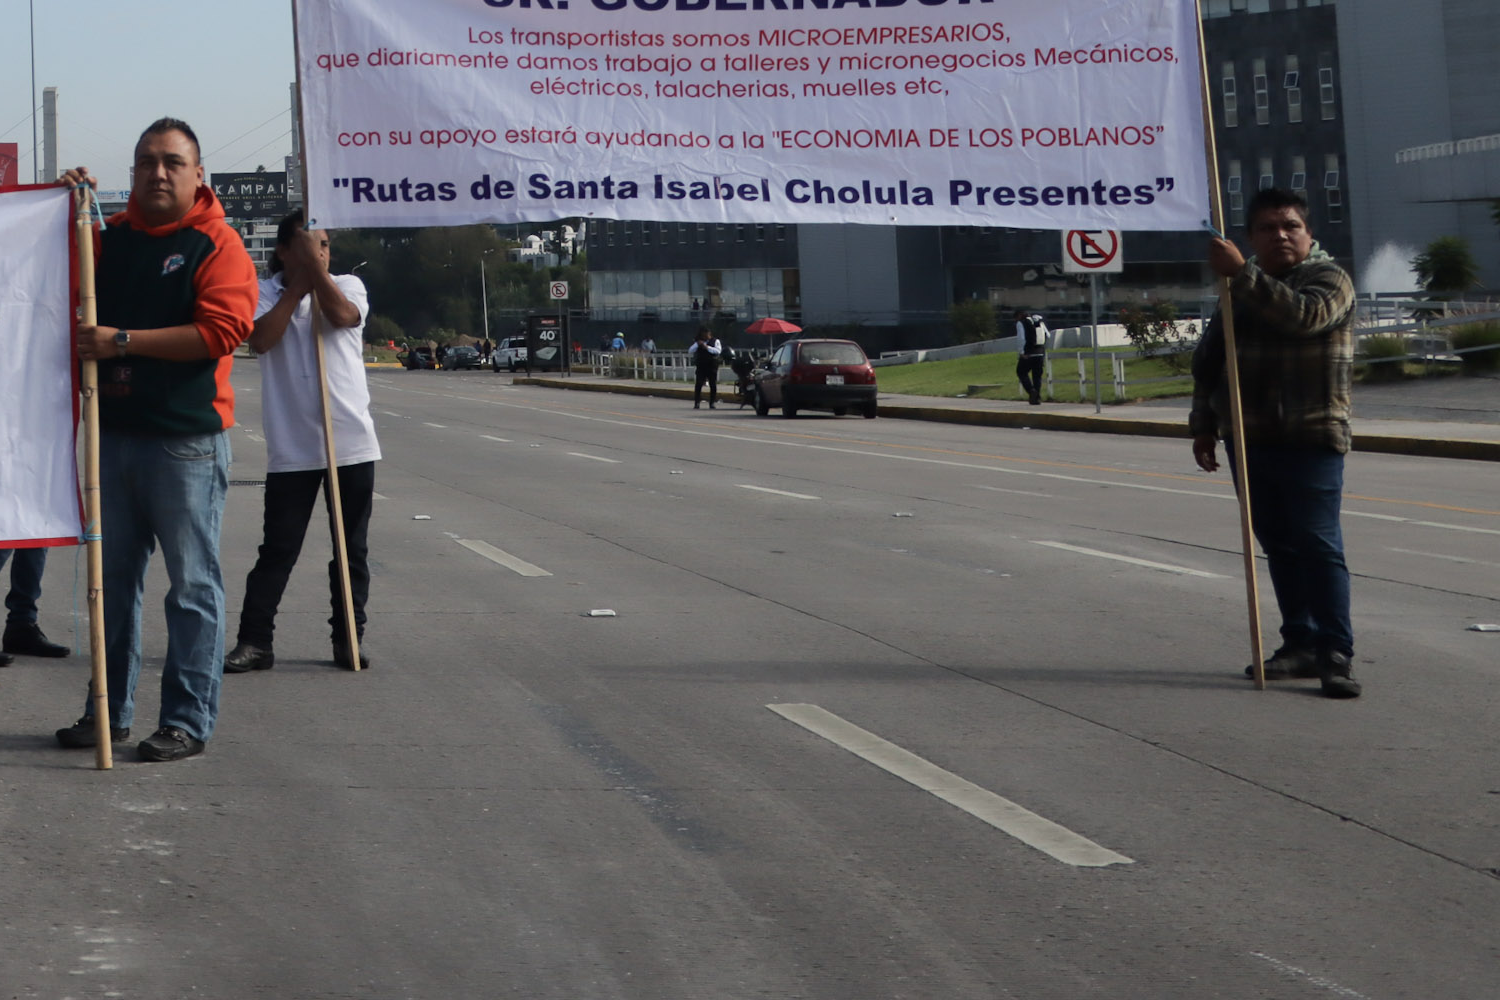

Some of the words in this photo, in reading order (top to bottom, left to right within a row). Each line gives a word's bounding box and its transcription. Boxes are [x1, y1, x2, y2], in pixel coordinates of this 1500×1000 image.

[468, 27, 504, 44] Los
[512, 27, 665, 50] transportistas
[672, 33, 750, 47] somos
[758, 22, 1011, 46] MICROEMPRESARIOS,
[317, 52, 359, 72] que
[367, 48, 508, 70] diariamente
[517, 53, 598, 71] damos
[605, 54, 692, 76] trabajo
[700, 58, 716, 72] a
[724, 54, 809, 72] talleres
[817, 56, 830, 75] y
[839, 49, 1026, 73] micronegocios
[1034, 43, 1179, 66] Mecánicos,
[530, 77, 649, 99] eléctricos,
[655, 80, 796, 100] talacherias,
[803, 78, 897, 97] muelles
[904, 76, 949, 96] etc,
[337, 131, 381, 147] con
[389, 129, 411, 145] su
[420, 127, 496, 148] apoyo
[505, 126, 577, 144] estará
[585, 129, 710, 148] ayudando
[718, 134, 734, 148] a
[743, 131, 764, 148] la
[772, 129, 920, 149] "ECONOMIA
[929, 128, 959, 148] DE
[969, 128, 1013, 148] LOS
[215, 183, 285, 195] KAMPAI
[332, 177, 457, 202] "Rutas
[471, 174, 515, 200] de
[528, 174, 639, 200] Santa
[654, 174, 770, 202] Isabel
[785, 179, 934, 205] Cholula
